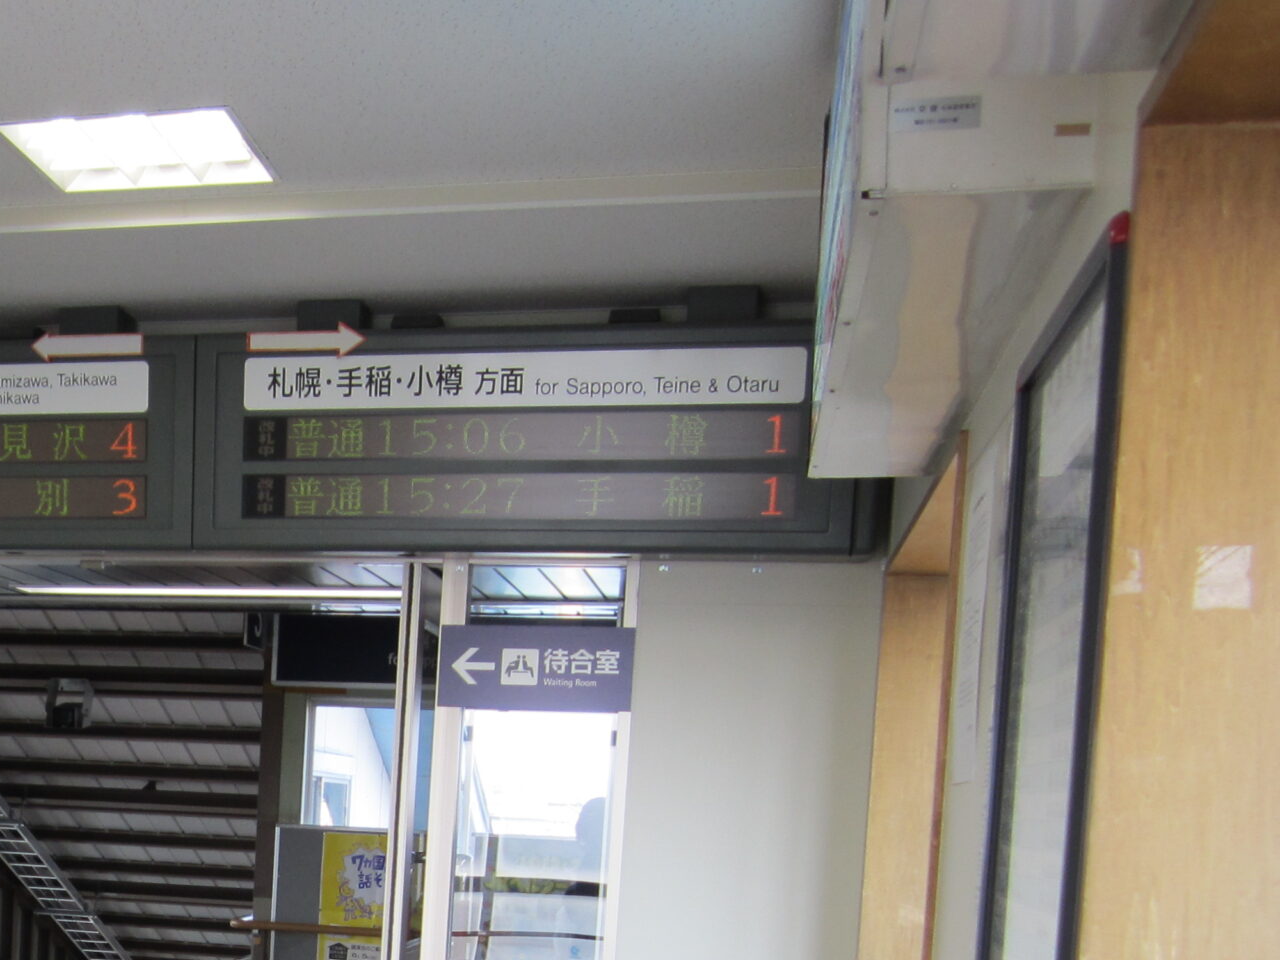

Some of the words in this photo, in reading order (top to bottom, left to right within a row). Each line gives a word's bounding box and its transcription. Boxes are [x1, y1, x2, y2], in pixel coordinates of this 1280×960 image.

[57, 372, 118, 387] Takikawa
[535, 378, 558, 395] for
[566, 377, 647, 399] Sapporo,
[656, 376, 703, 394] Teine
[708, 376, 720, 393] &
[726, 375, 780, 393] Otaru
[110, 423, 138, 458] 4
[290, 417, 364, 458] 普通
[378, 418, 526, 456] 15:06
[765, 417, 787, 454] 1
[112, 480, 138, 515] 3
[288, 477, 363, 518] 普通
[376, 477, 526, 516] 15:27
[761, 477, 783, 515] 1
[543, 648, 620, 674] 待合室
[543, 678, 573, 688] Waiting
[575, 679, 597, 687] Room
